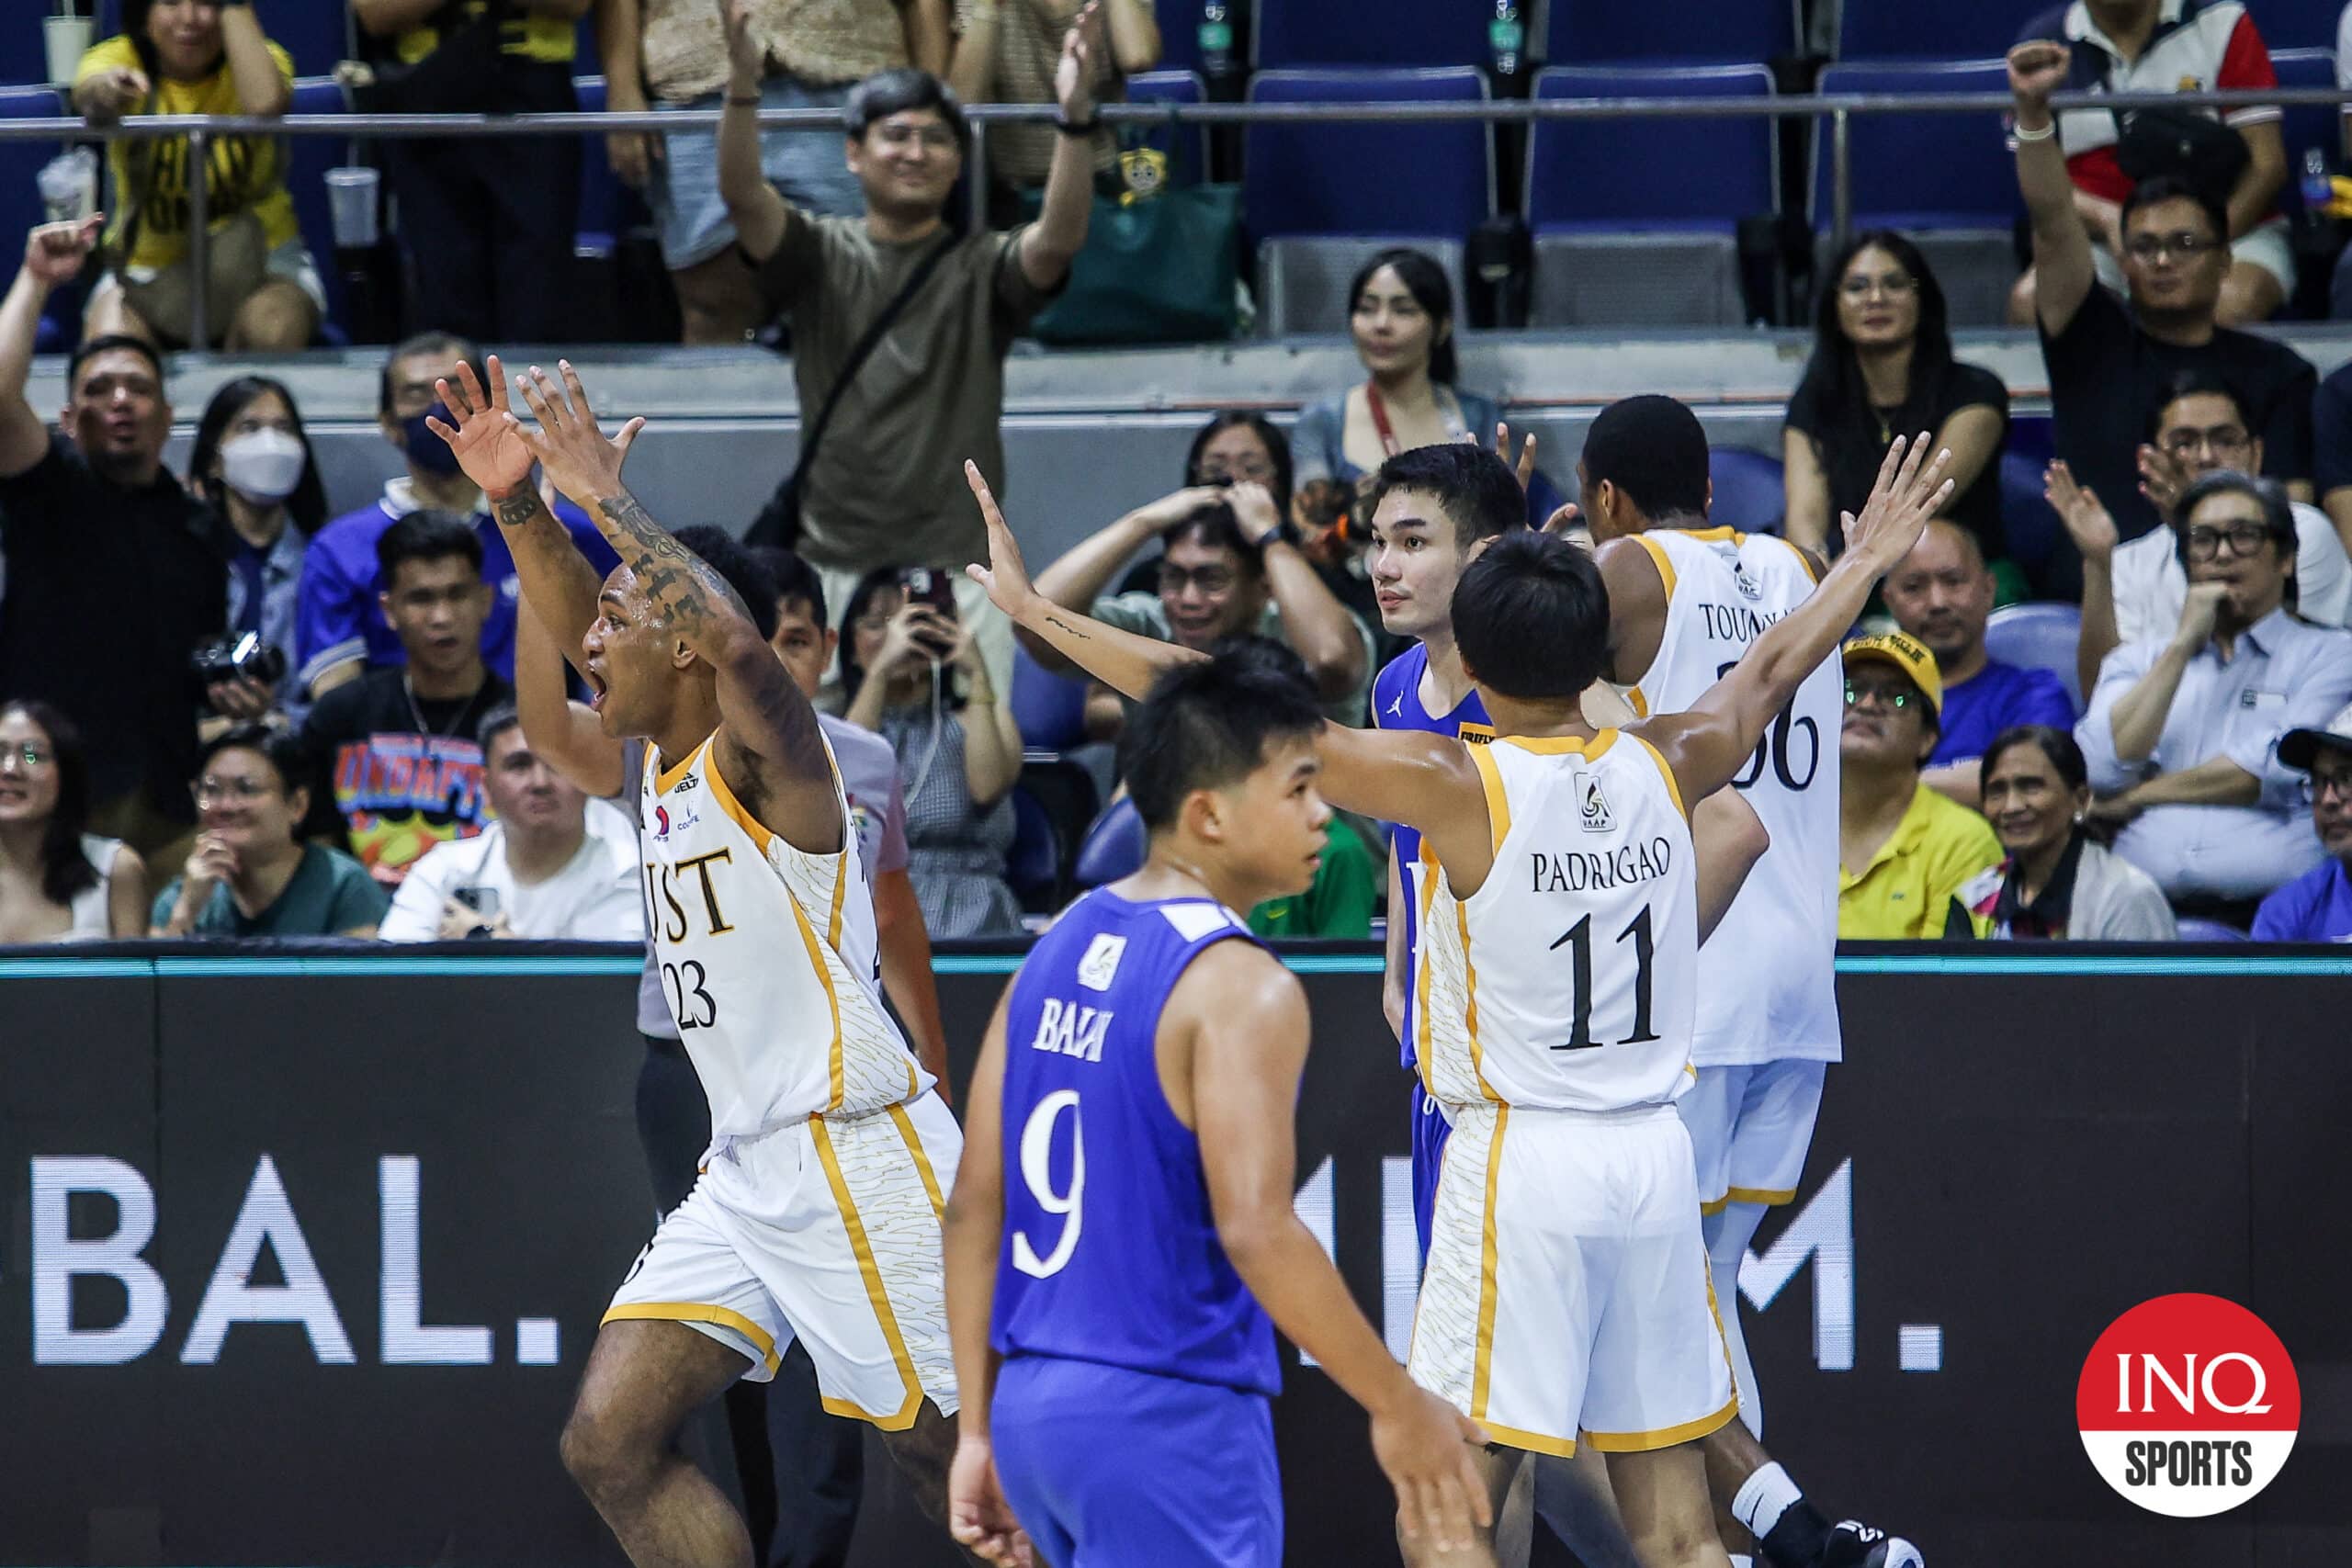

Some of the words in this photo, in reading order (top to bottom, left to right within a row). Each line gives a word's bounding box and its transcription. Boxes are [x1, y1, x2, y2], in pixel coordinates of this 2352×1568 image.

[1531, 837, 1670, 892] PADRIGAO
[1550, 902, 1662, 1051] 11
[30, 1154, 560, 1366] BAL.
[1012, 1089, 1086, 1279] 9
